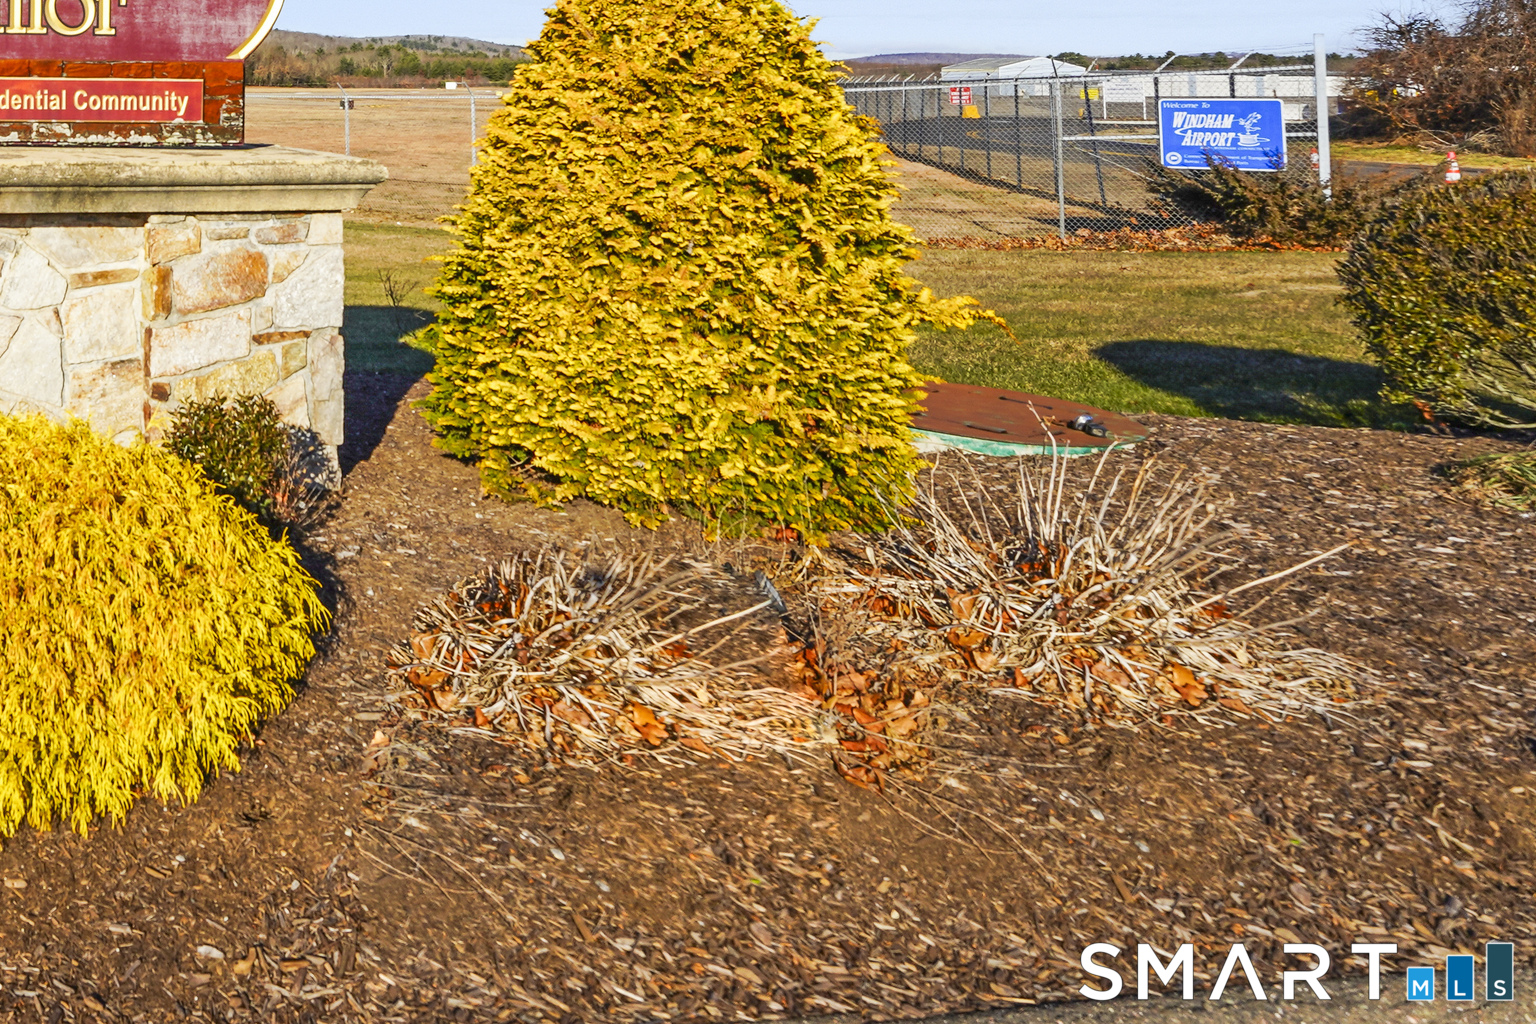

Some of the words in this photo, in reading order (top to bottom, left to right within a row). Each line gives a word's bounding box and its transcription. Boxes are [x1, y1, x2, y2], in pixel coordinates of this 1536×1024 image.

[73, 90, 189, 116] Community
[1172, 111, 1235, 128] WINDHAM
[1181, 129, 1236, 146] AIRPORT
